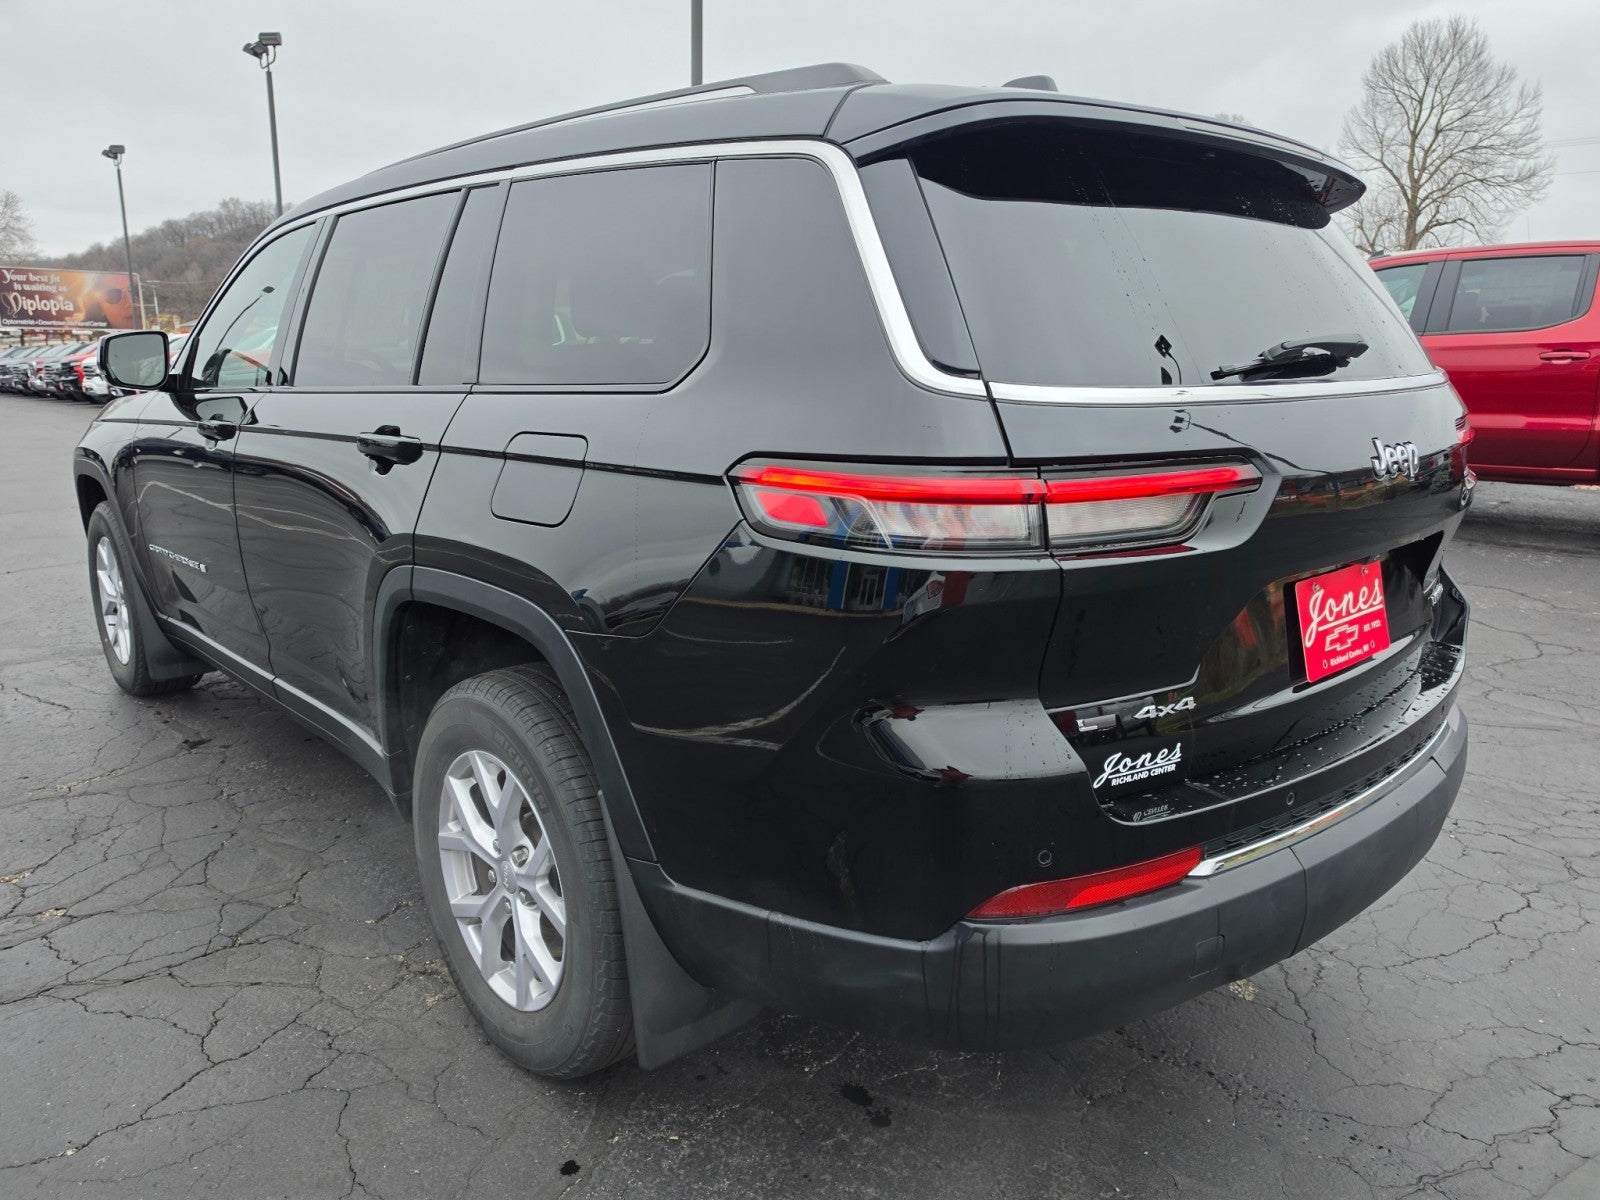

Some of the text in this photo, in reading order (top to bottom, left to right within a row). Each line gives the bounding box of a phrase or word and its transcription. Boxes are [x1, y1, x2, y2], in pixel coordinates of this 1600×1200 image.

[2, 269, 27, 283] Your
[29, 273, 48, 282] best
[14, 282, 21, 291] is
[23, 283, 57, 293] waiting
[9, 292, 74, 318] Diplopia
[1370, 437, 1420, 481] Jeep
[1305, 578, 1383, 647] Jones
[1133, 697, 1196, 719] 4x4
[1093, 743, 1182, 788] Jones
[1111, 764, 1177, 786] RICHLAND CENTER
